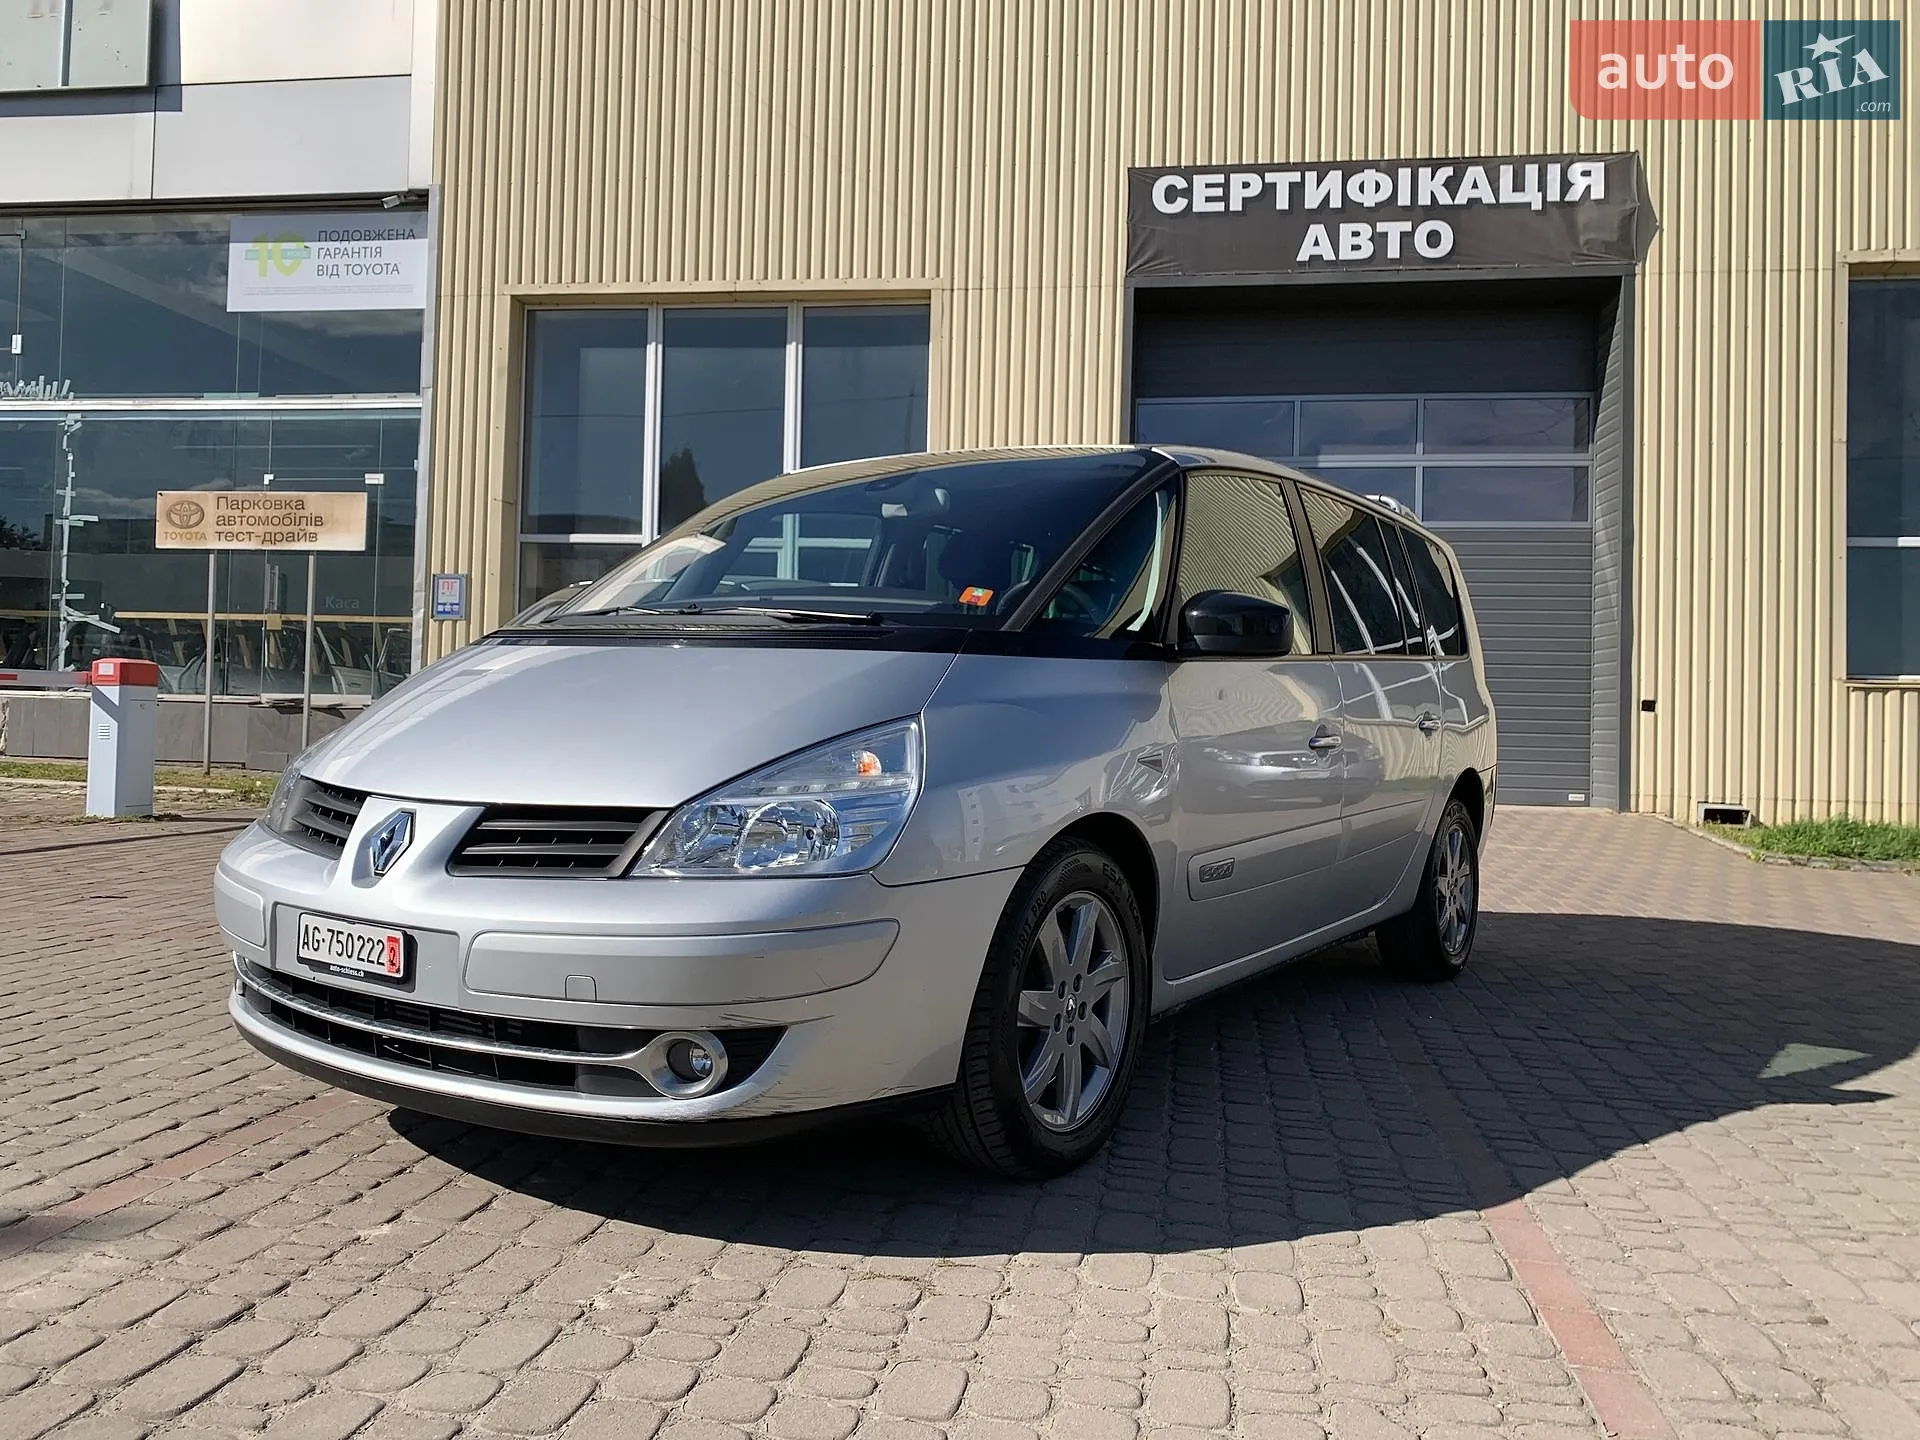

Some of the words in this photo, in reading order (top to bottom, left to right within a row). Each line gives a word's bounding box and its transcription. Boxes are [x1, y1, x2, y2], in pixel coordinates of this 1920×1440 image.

[1151, 162, 1605, 214] СЕРТИФІКАЦІЯ
[317, 228, 416, 244] ПОДОВЖЕНА
[1296, 219, 1455, 263] АВТО
[317, 246, 383, 260] ГАРАНТІЯ
[316, 264, 340, 279] ВІД
[344, 263, 401, 277] TOYOTA
[216, 496, 306, 515] Парковка
[215, 512, 324, 527] автомобілів
[164, 531, 208, 541] TOYOTA
[215, 529, 318, 545] тест-драйв
[325, 596, 360, 609] Каса
[1032, 890, 1047, 917] PRO
